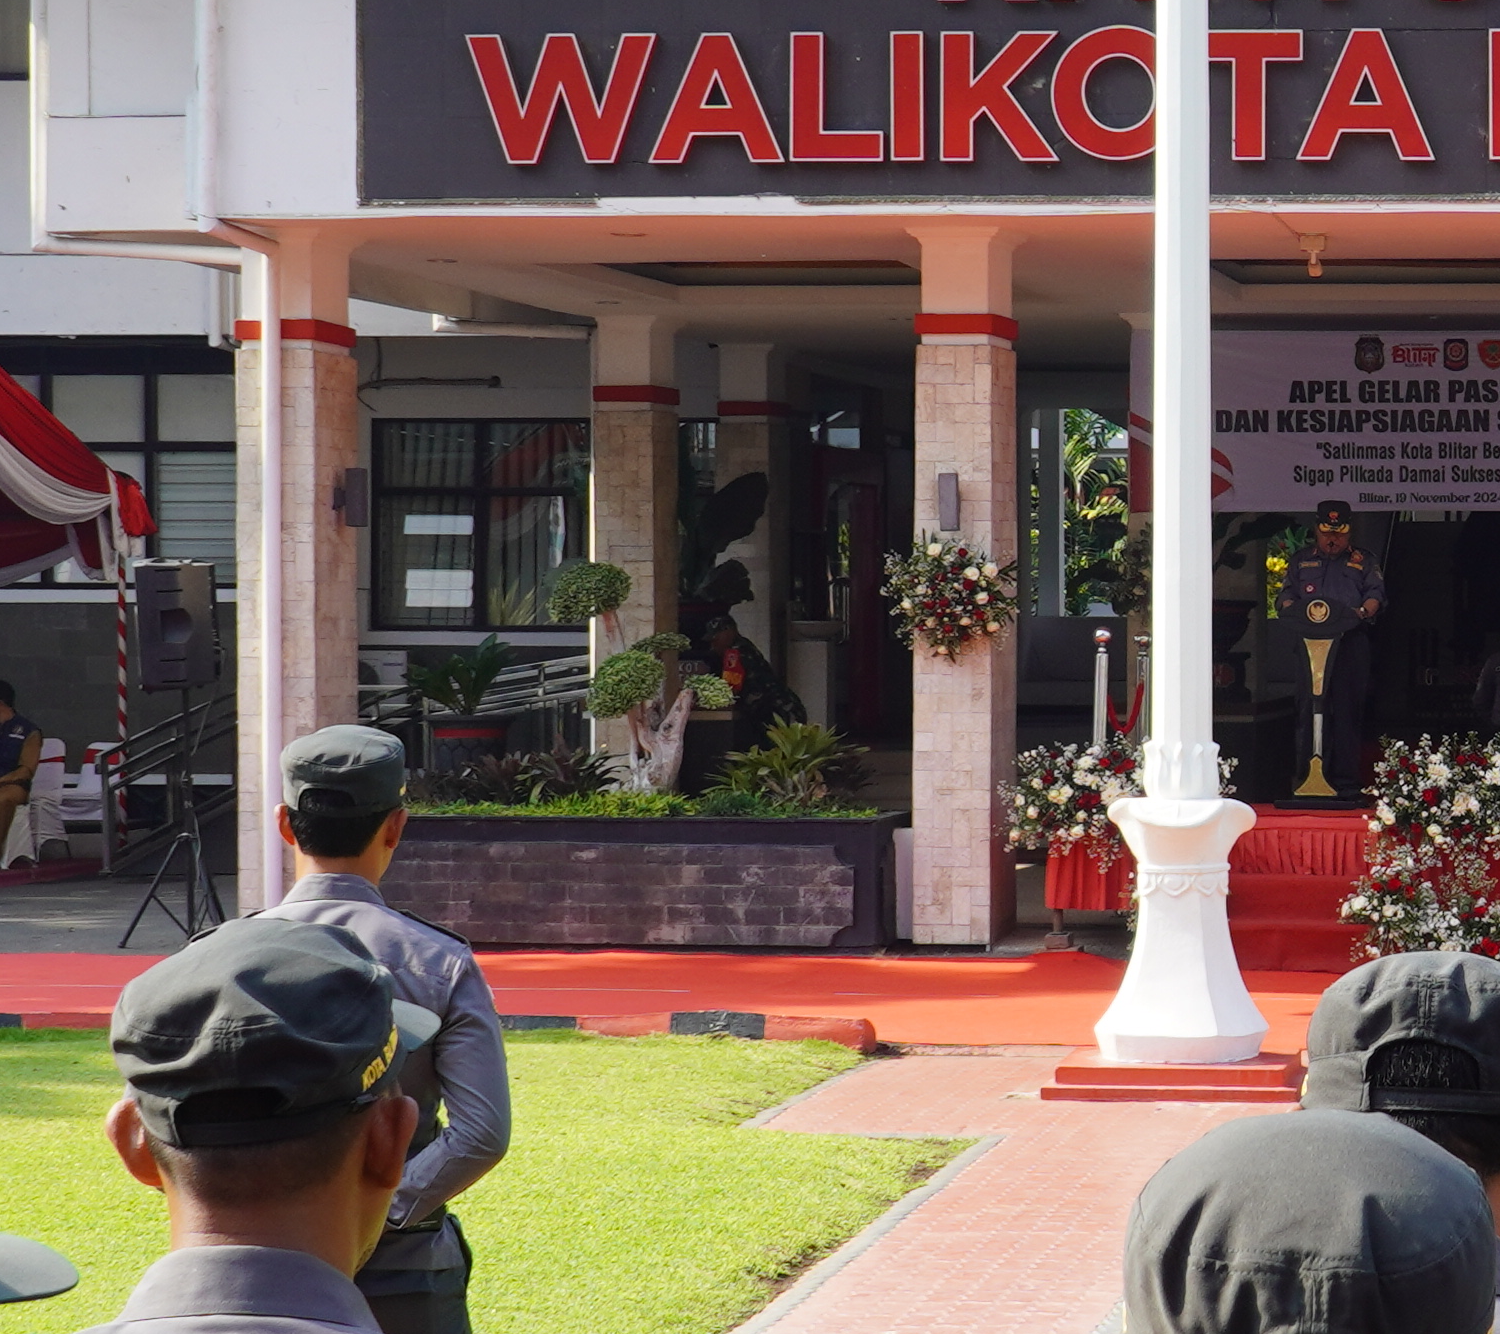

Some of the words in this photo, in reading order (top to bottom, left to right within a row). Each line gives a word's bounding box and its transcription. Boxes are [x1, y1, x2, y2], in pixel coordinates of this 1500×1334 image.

[465, 26, 1433, 165] WALIKOTA
[1289, 380, 1351, 403] APEL
[1358, 379, 1440, 403] GELAR
[1215, 409, 1269, 433] DAN
[1277, 409, 1490, 433] KESIAPSIAGAAN
[1401, 442, 1433, 460] Kota
[1438, 442, 1477, 460] Blitar
[1293, 465, 1334, 486] Sigap
[1340, 465, 1393, 483] Pilkada
[1399, 465, 1446, 483] Damai
[1359, 492, 1392, 505] Blitar,
[1395, 492, 1407, 503] 19
[1410, 492, 1470, 503] November
